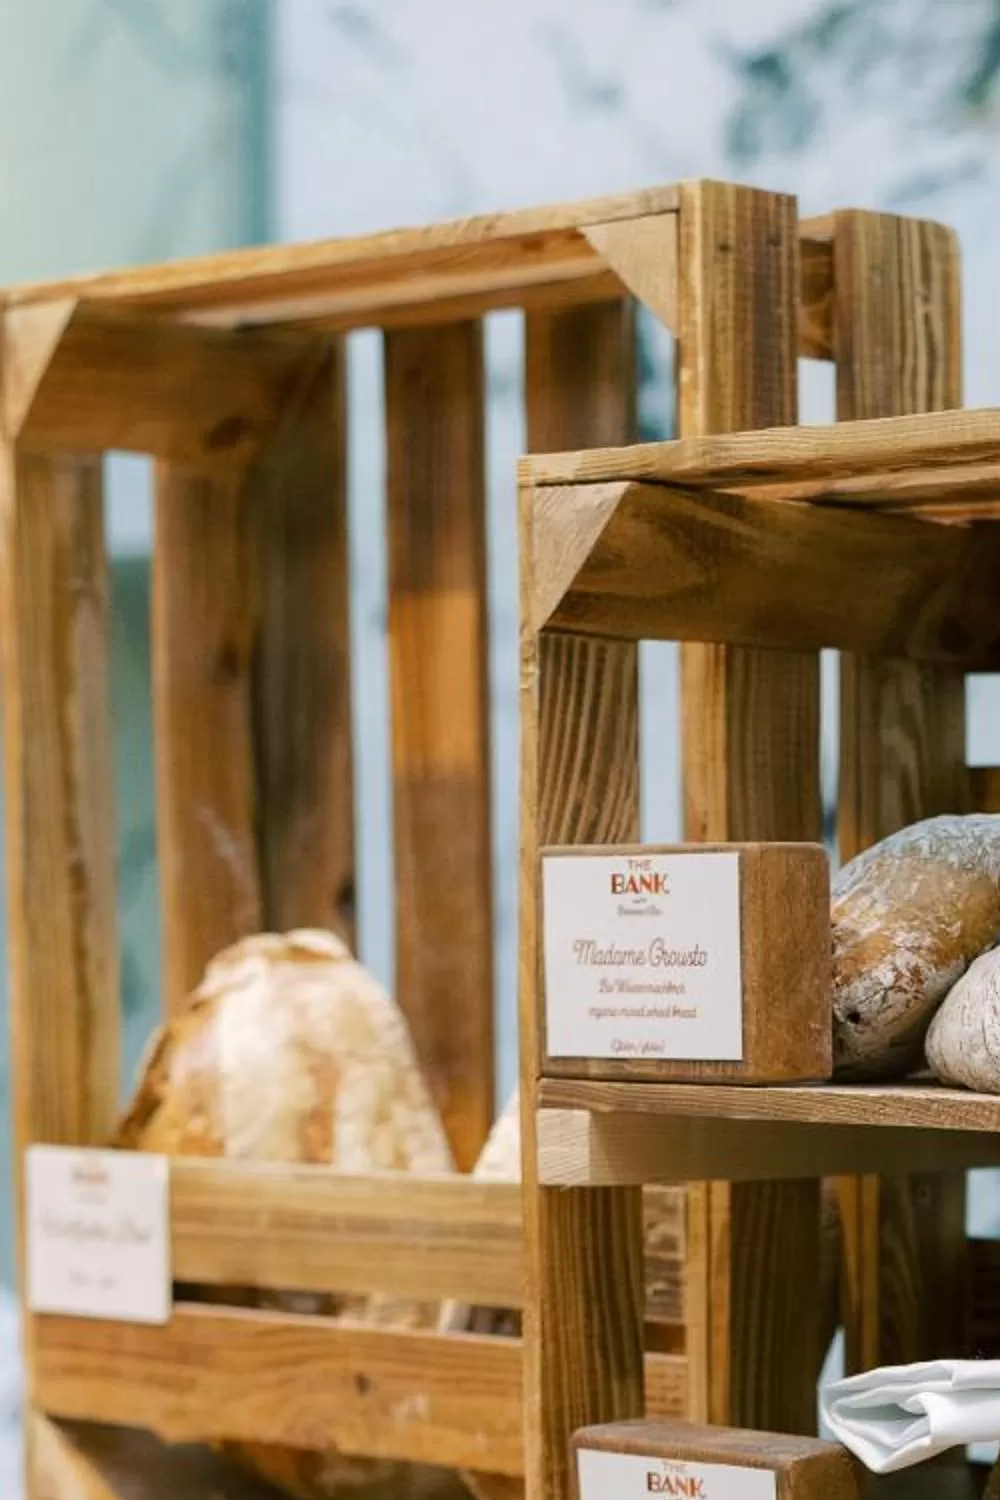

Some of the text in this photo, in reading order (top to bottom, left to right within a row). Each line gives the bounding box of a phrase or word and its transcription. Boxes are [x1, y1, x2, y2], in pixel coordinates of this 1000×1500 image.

[629, 860, 652, 871] THE
[611, 874, 670, 895] BANK
[573, 939, 646, 966] Madame
[647, 1472, 707, 1500] BANK
